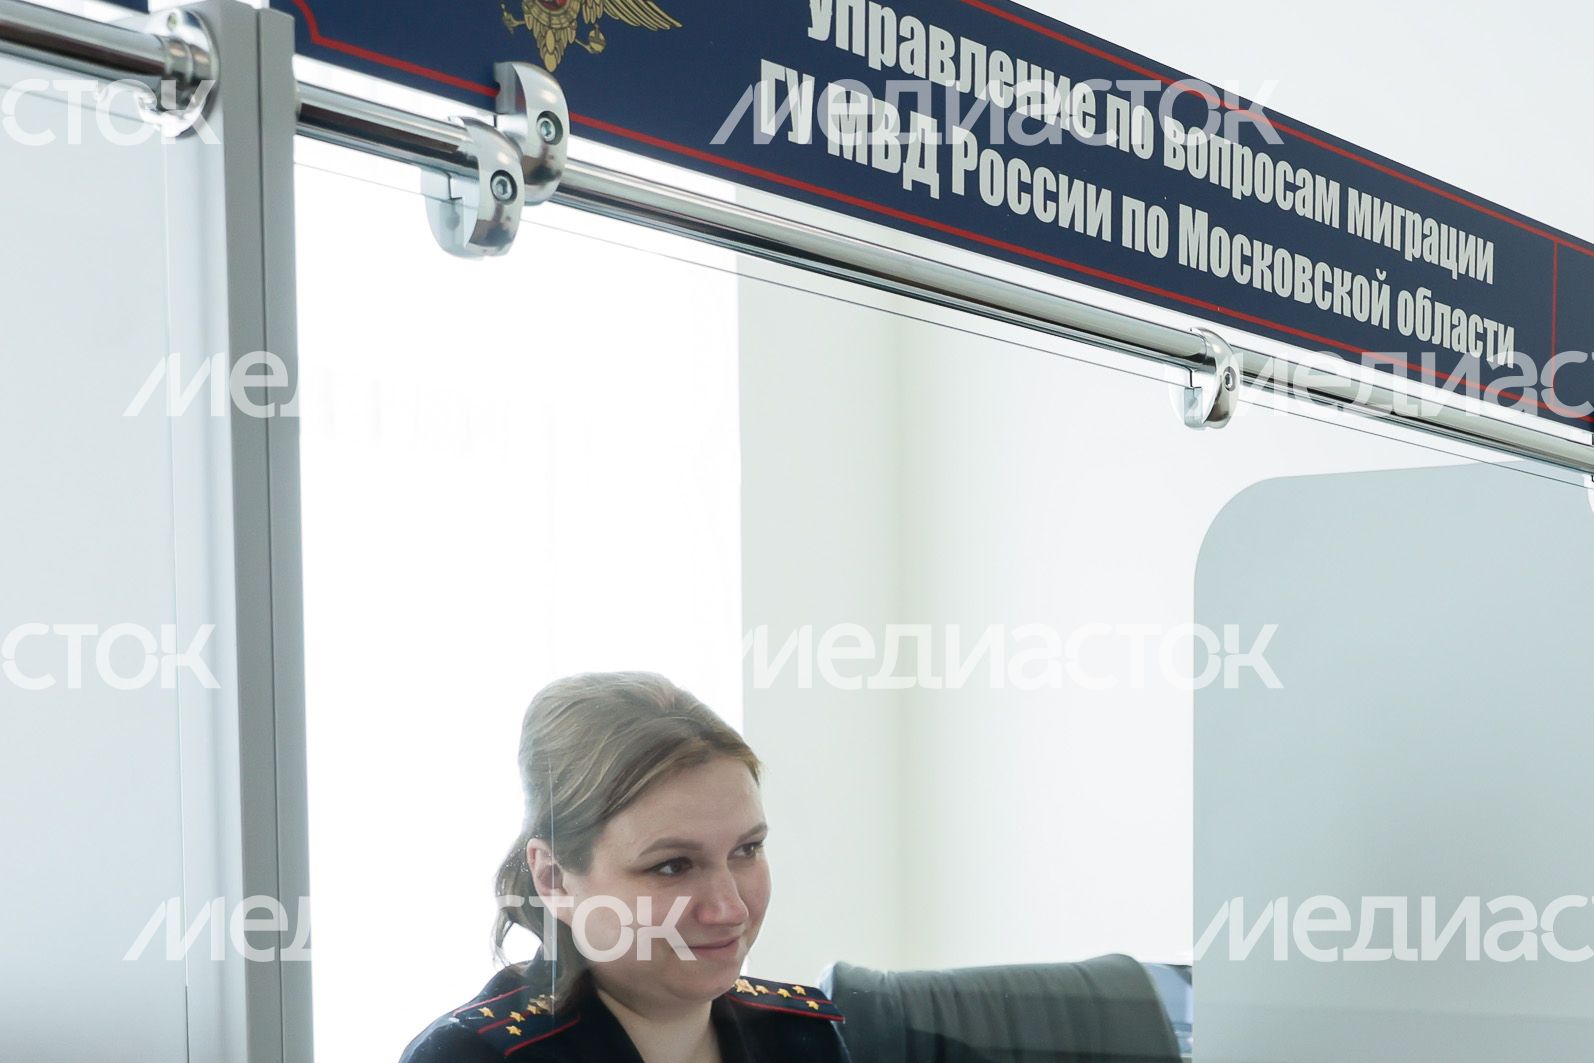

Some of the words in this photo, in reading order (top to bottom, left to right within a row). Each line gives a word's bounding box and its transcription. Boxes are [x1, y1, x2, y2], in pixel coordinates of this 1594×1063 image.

[760, 58, 815, 145] ГУ
[827, 82, 940, 200] МВД
[951, 125, 1112, 243] России
[1121, 194, 1169, 260] по
[1177, 203, 1391, 331] Московской
[1397, 286, 1516, 369] области
[1106, 93, 1154, 160] по
[1163, 115, 1341, 230] вопросам
[1347, 187, 1495, 285] миграции
